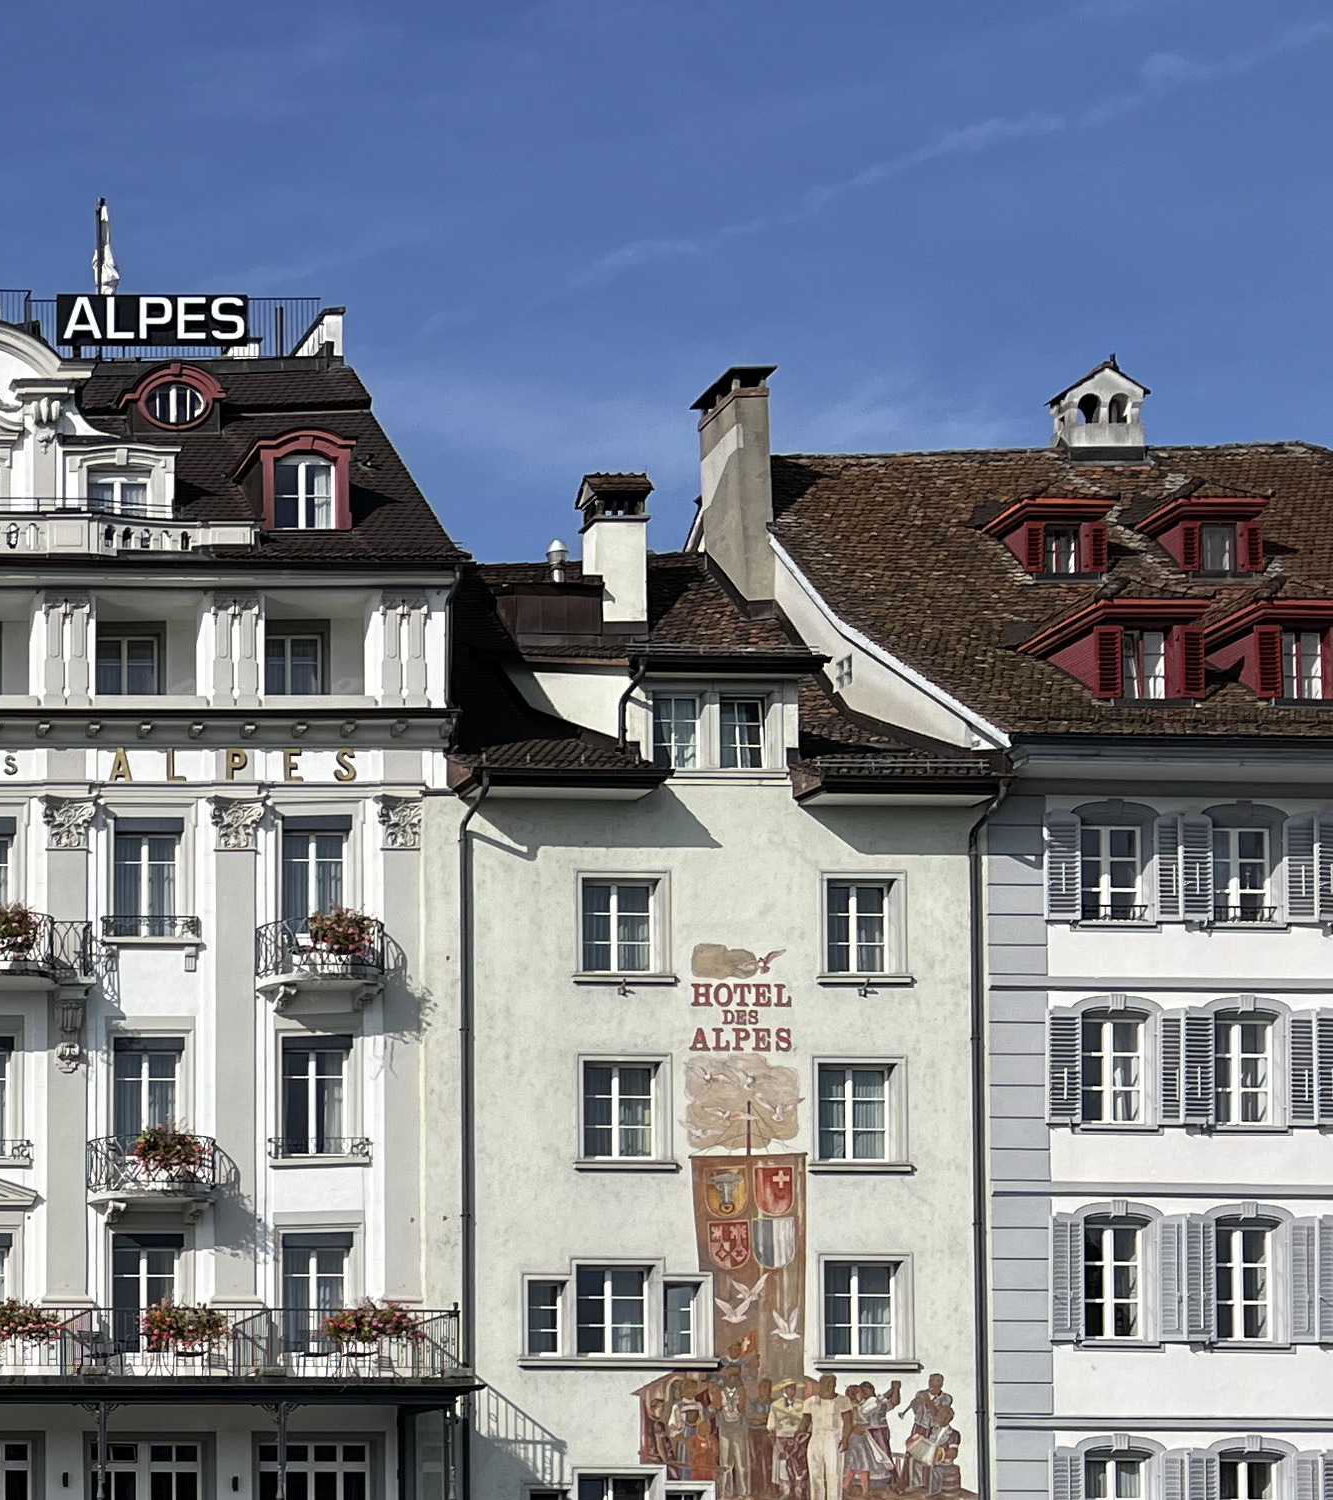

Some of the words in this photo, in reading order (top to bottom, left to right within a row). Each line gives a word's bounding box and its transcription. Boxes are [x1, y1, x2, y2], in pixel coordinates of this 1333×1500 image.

[62, 296, 246, 341] ALPES
[109, 747, 357, 783] ALPES
[690, 983, 792, 1007] HOTEL
[721, 1009, 760, 1026] DES
[689, 1027, 792, 1052] ALPES
